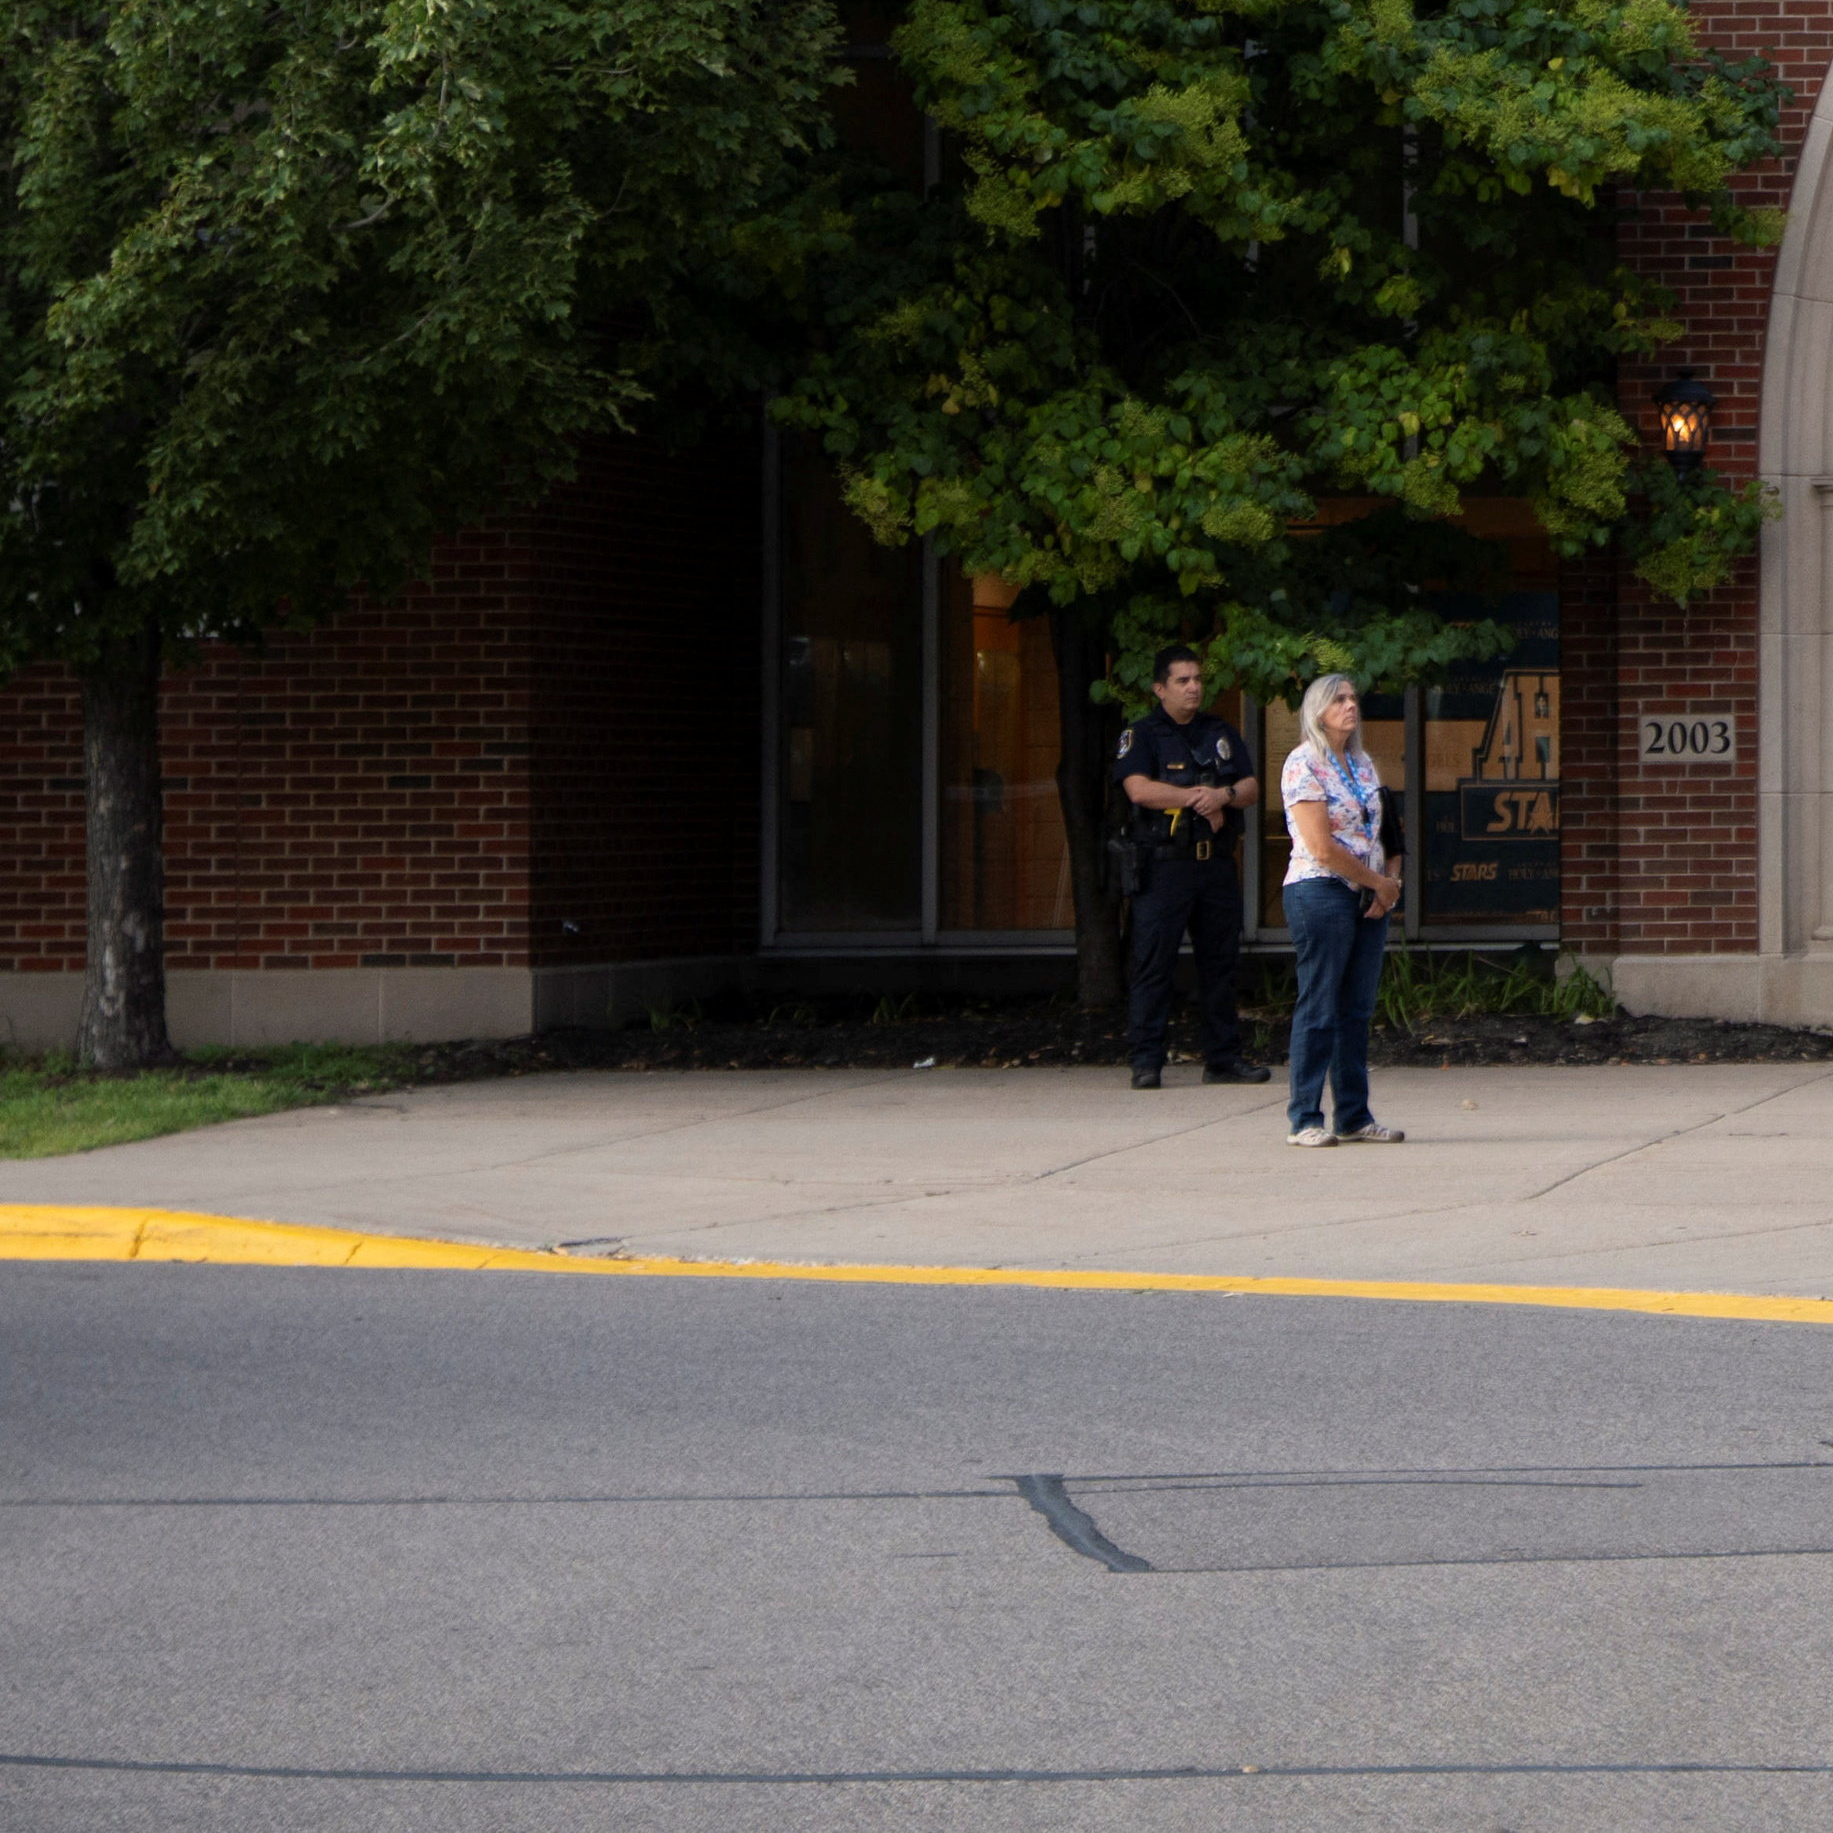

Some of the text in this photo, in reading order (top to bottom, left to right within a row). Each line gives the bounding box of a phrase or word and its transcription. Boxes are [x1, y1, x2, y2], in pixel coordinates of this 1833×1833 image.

[1537, 627, 1559, 640] ANG
[1645, 722, 1730, 754] 2003
[1485, 791, 1560, 833] STA
[1449, 862, 1498, 882] STARS
